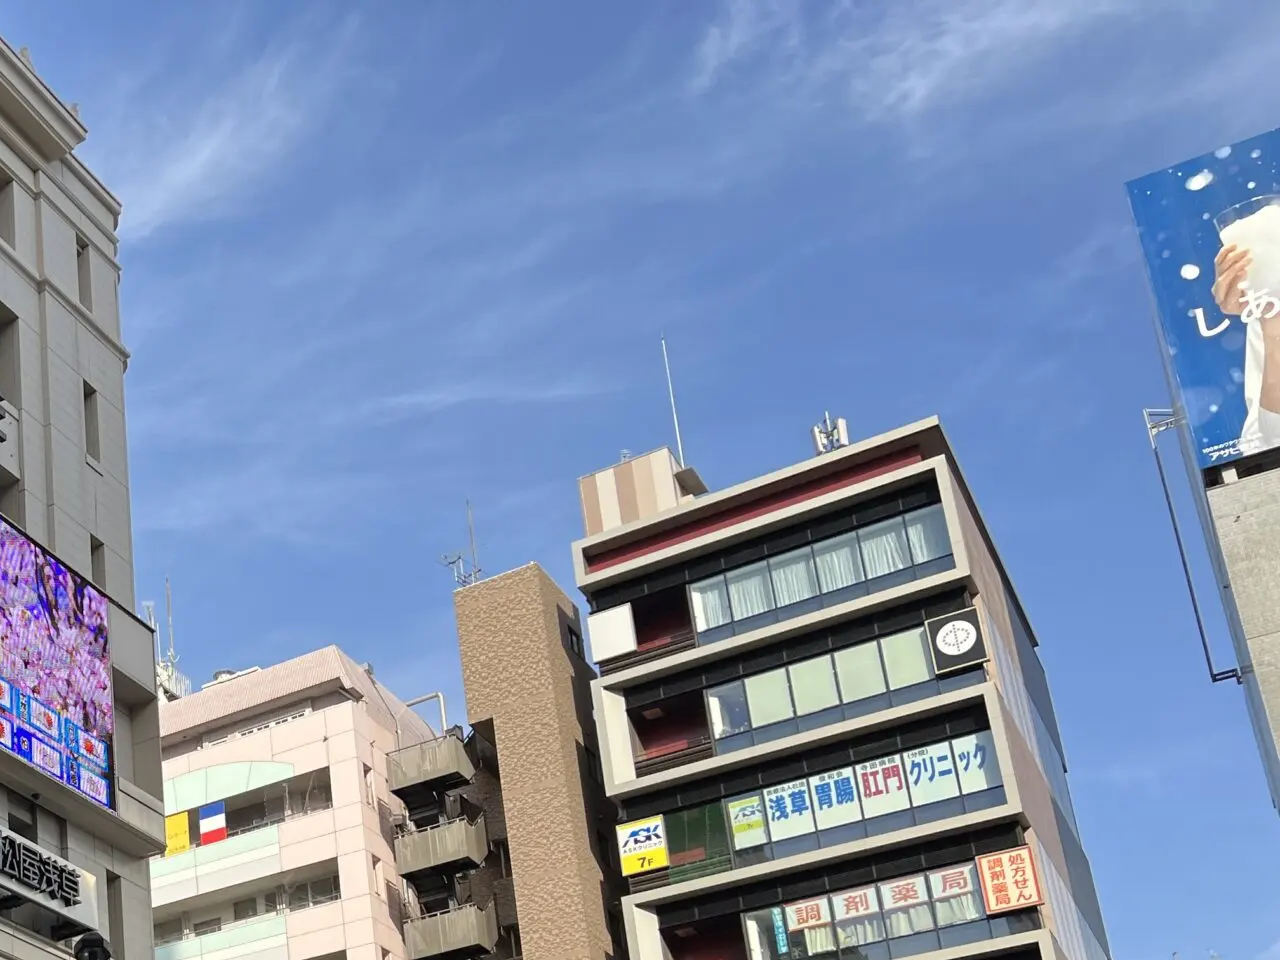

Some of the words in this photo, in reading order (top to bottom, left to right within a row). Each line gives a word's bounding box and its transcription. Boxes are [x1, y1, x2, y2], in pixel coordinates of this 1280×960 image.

[622, 824, 663, 849] ASK
[637, 856, 654, 869] 7F
[987, 858, 1011, 906] 調剤薬局
[1008, 853, 1032, 903] 処方せん
[795, 870, 969, 926] 調剤薬局
